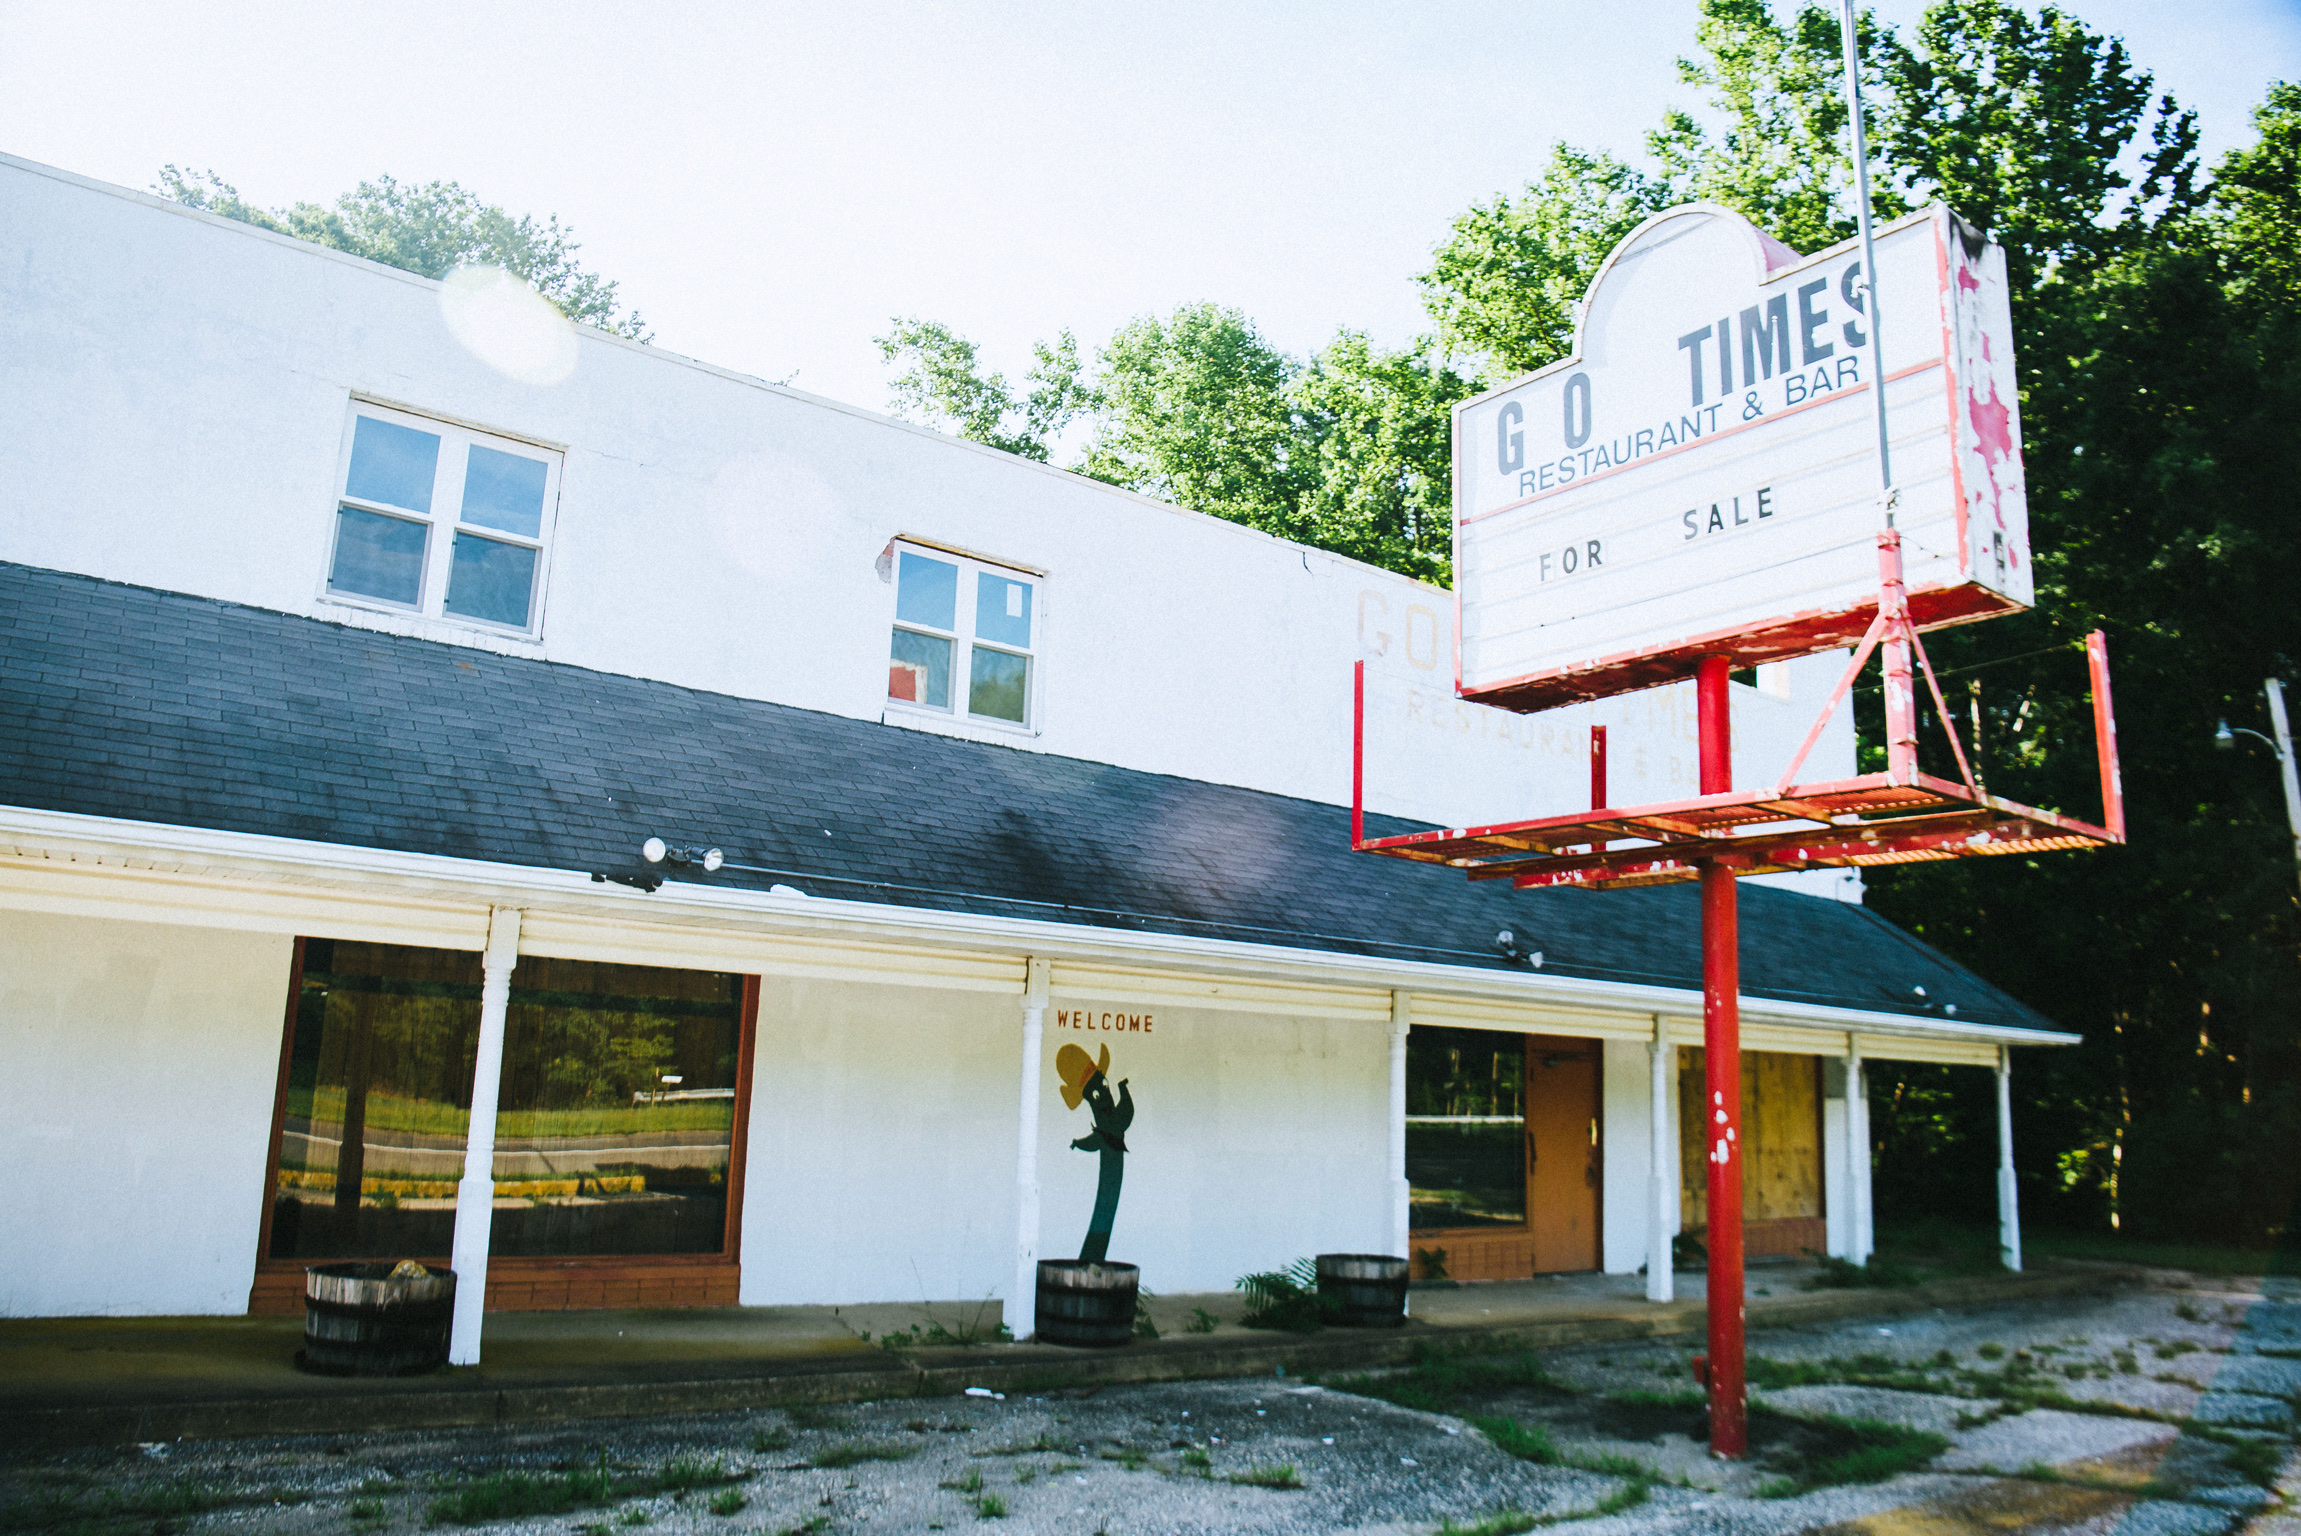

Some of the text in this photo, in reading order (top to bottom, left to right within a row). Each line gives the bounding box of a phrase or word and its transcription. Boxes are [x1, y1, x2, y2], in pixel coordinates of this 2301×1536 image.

[1677, 261, 1867, 406] TIMES
[1519, 355, 1860, 497] RESTAURANT & BAR
[1540, 487, 1773, 582] FOR SALE
[1407, 690, 1608, 761] RESTAURAN
[1057, 1010, 1153, 1033] WELCOME
